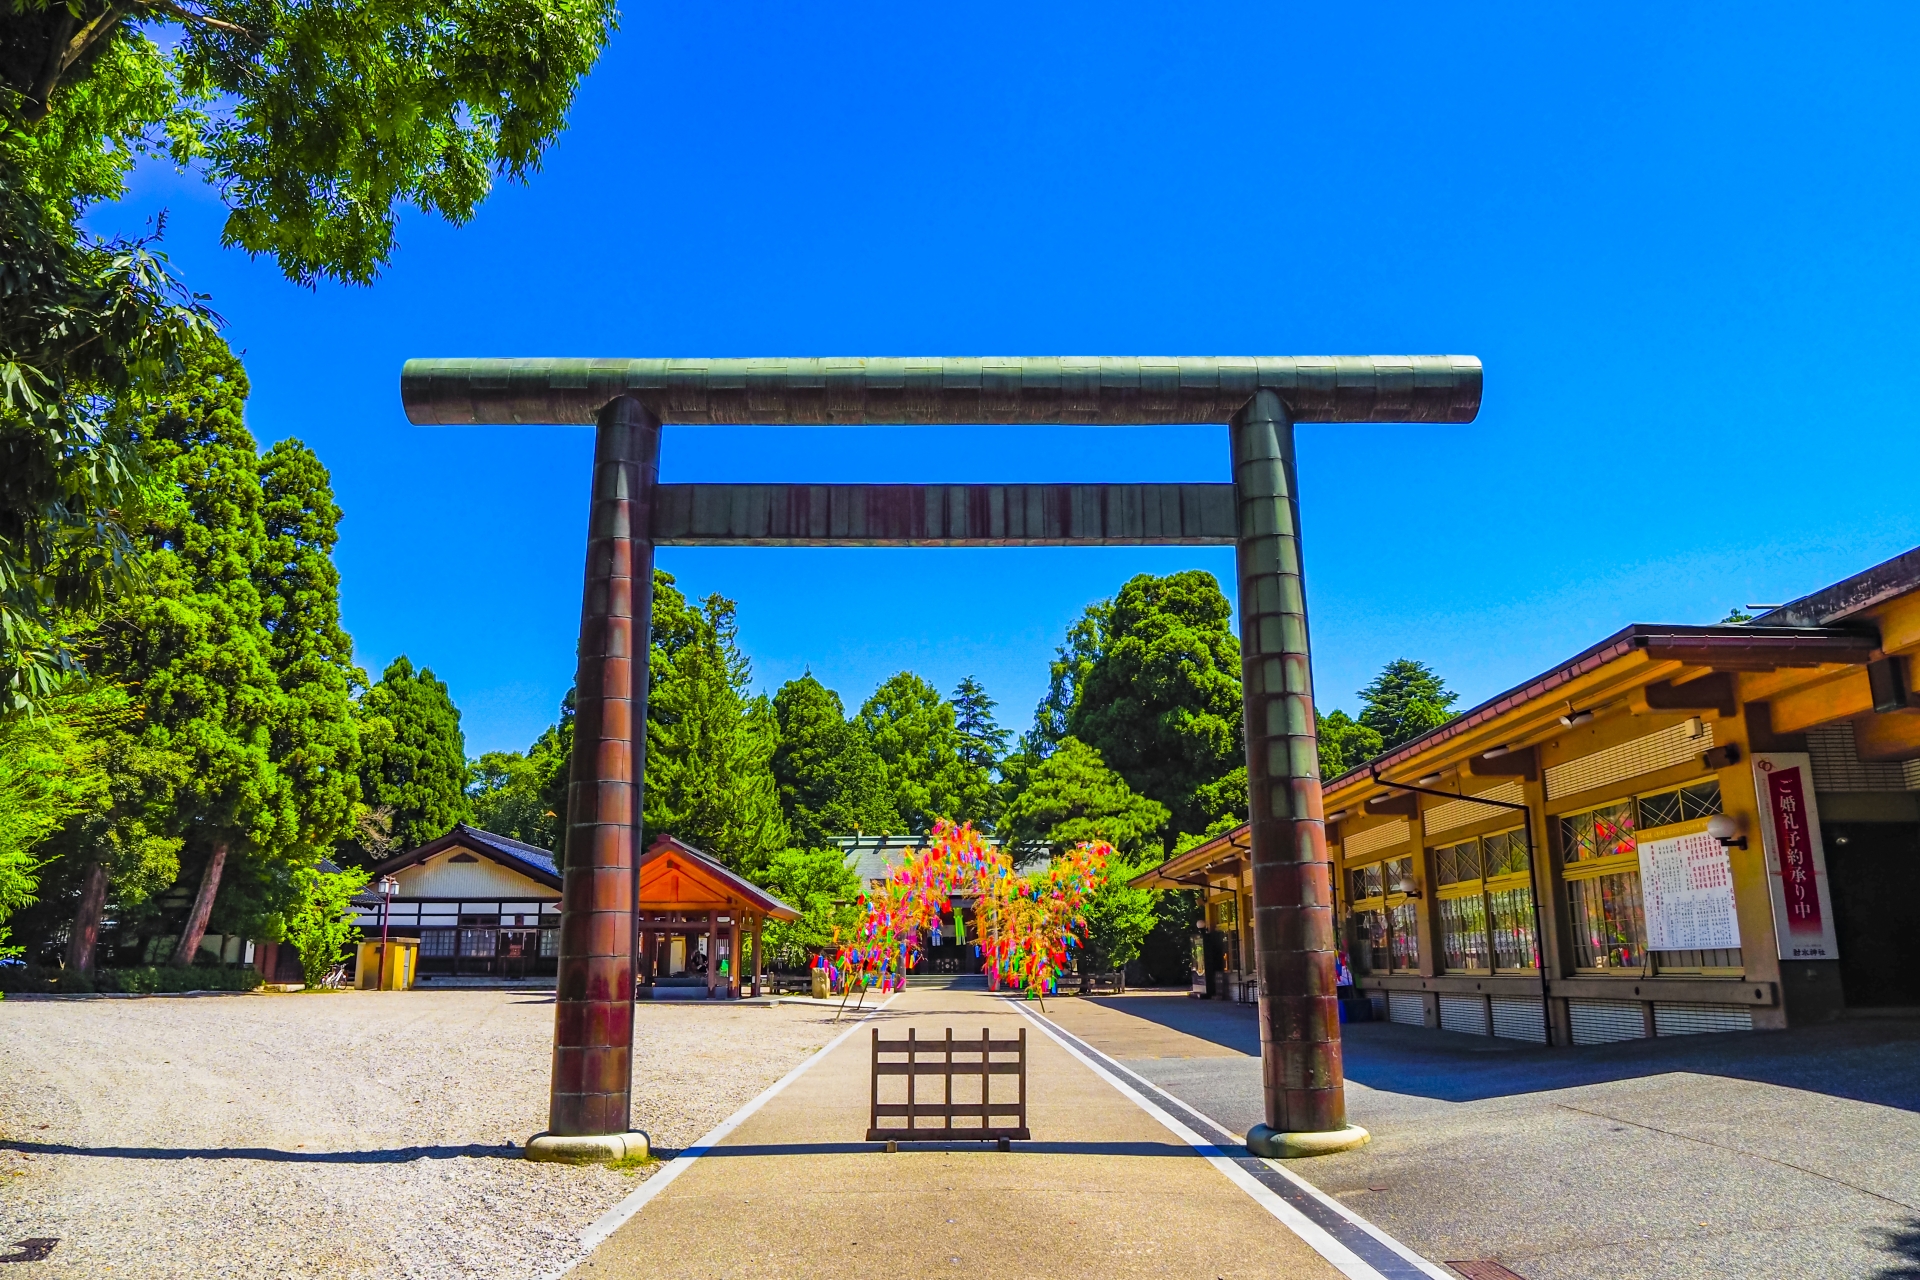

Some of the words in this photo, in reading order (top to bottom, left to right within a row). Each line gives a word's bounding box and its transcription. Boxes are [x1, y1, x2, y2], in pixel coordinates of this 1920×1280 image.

[1778, 779, 1811, 919] ご婚礼予約承り中
